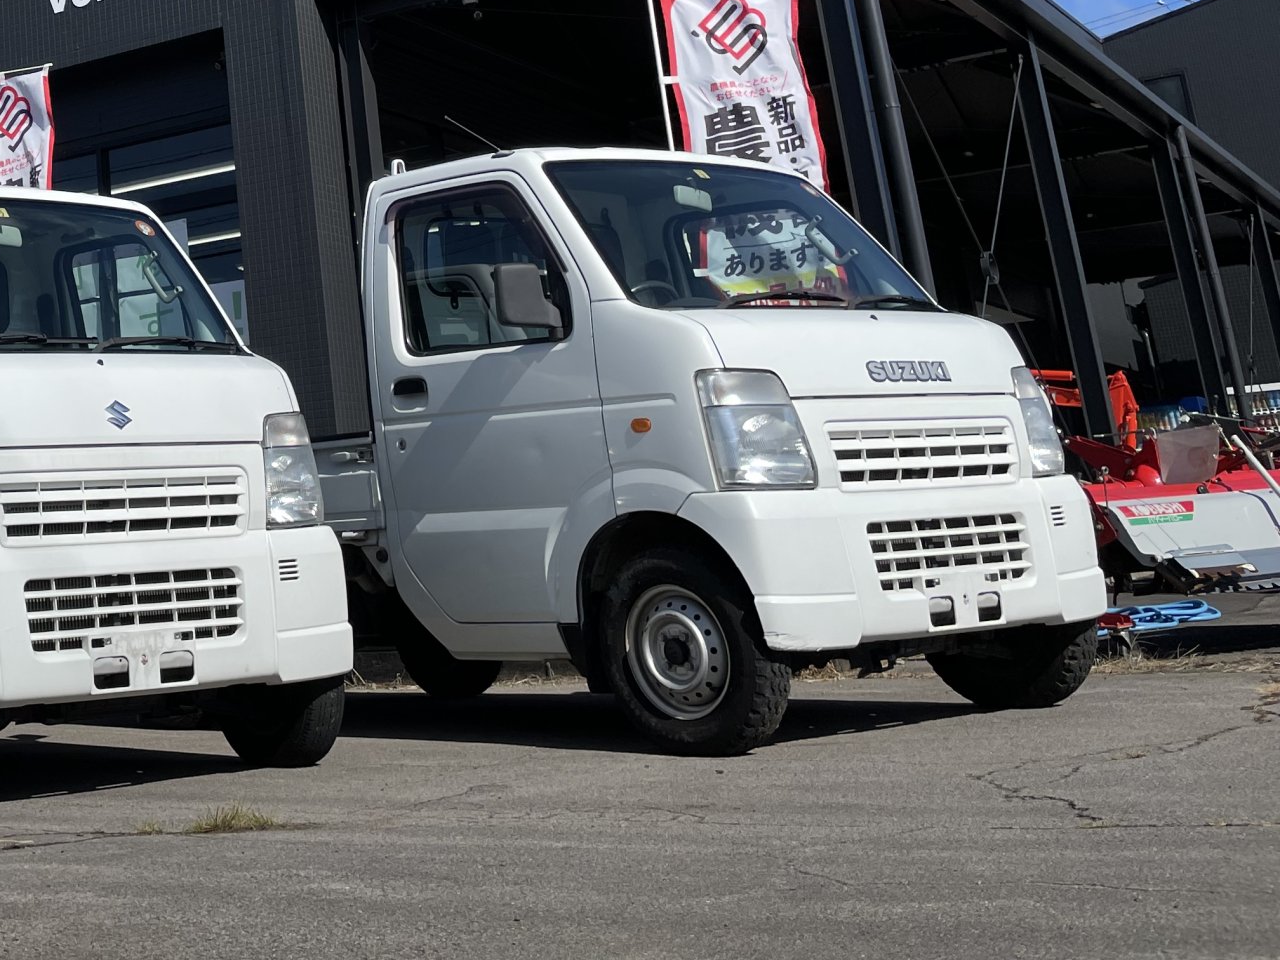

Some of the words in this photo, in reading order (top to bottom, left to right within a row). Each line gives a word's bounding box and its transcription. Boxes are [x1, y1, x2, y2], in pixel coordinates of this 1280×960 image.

[767, 93, 809, 179] 新品・
[865, 360, 952, 382] SUZUKI
